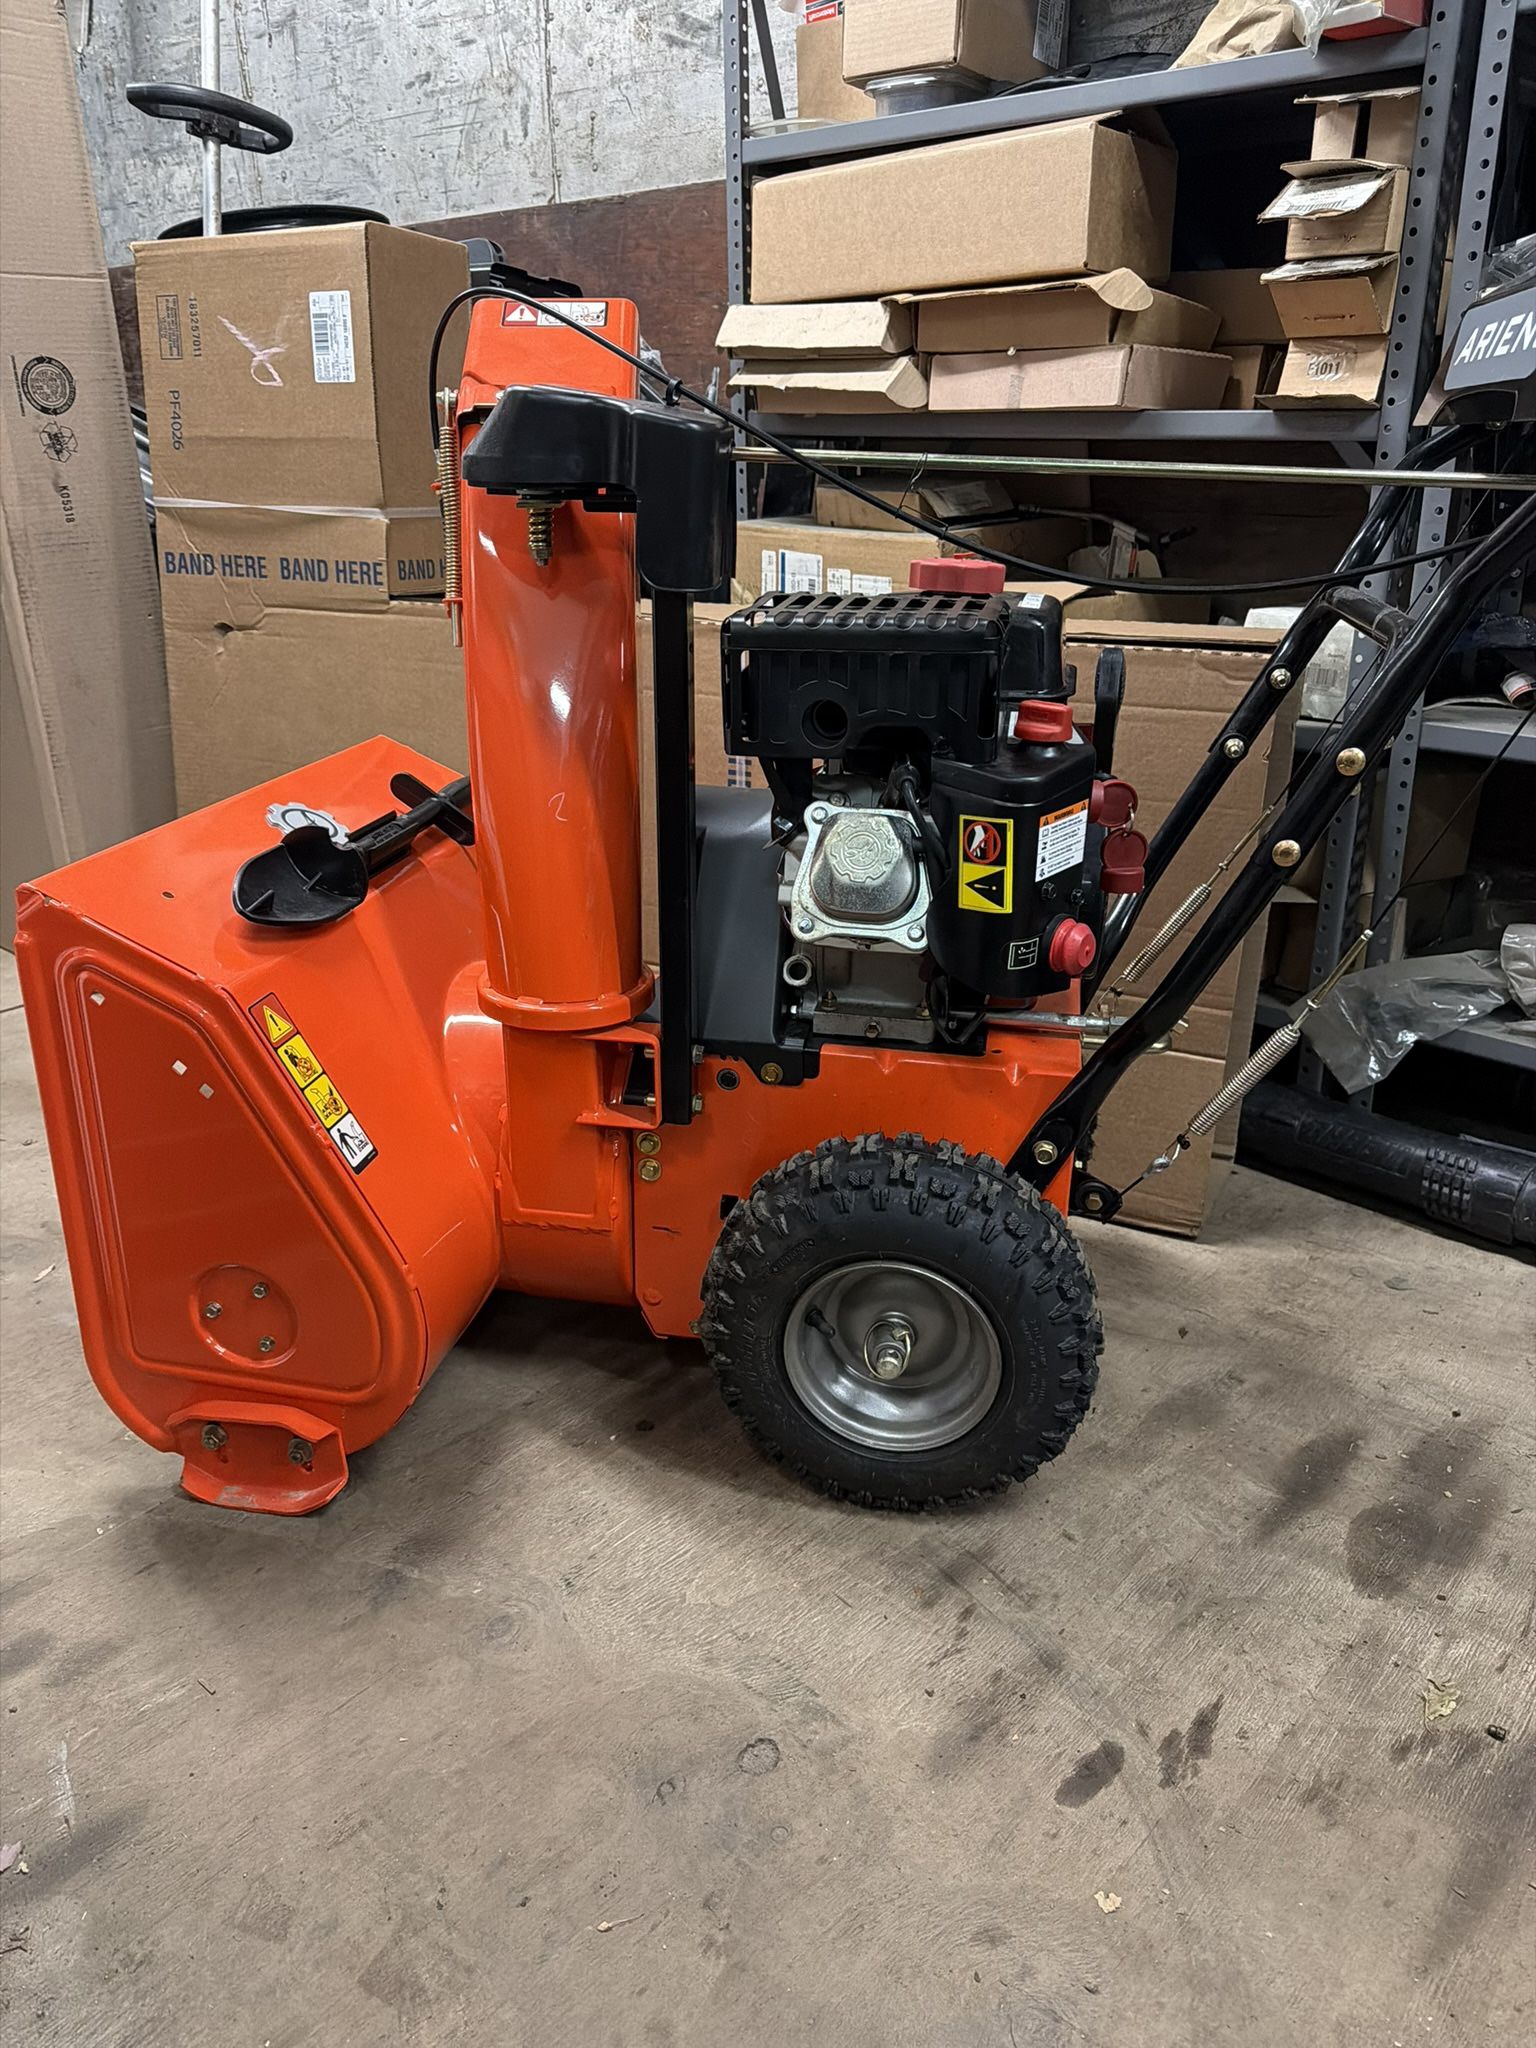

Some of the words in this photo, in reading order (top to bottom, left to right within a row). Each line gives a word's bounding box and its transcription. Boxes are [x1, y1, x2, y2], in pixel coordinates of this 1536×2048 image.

[187, 297, 202, 359] 183257011
[1453, 310, 1536, 366] ARIEN
[168, 389, 186, 451] PF4026
[59, 485, 76, 524] K05318
[164, 551, 217, 576] BAND
[221, 554, 269, 580] HERE
[279, 557, 329, 583] BAND
[335, 560, 385, 586] HERE
[397, 558, 436, 582] BAND
